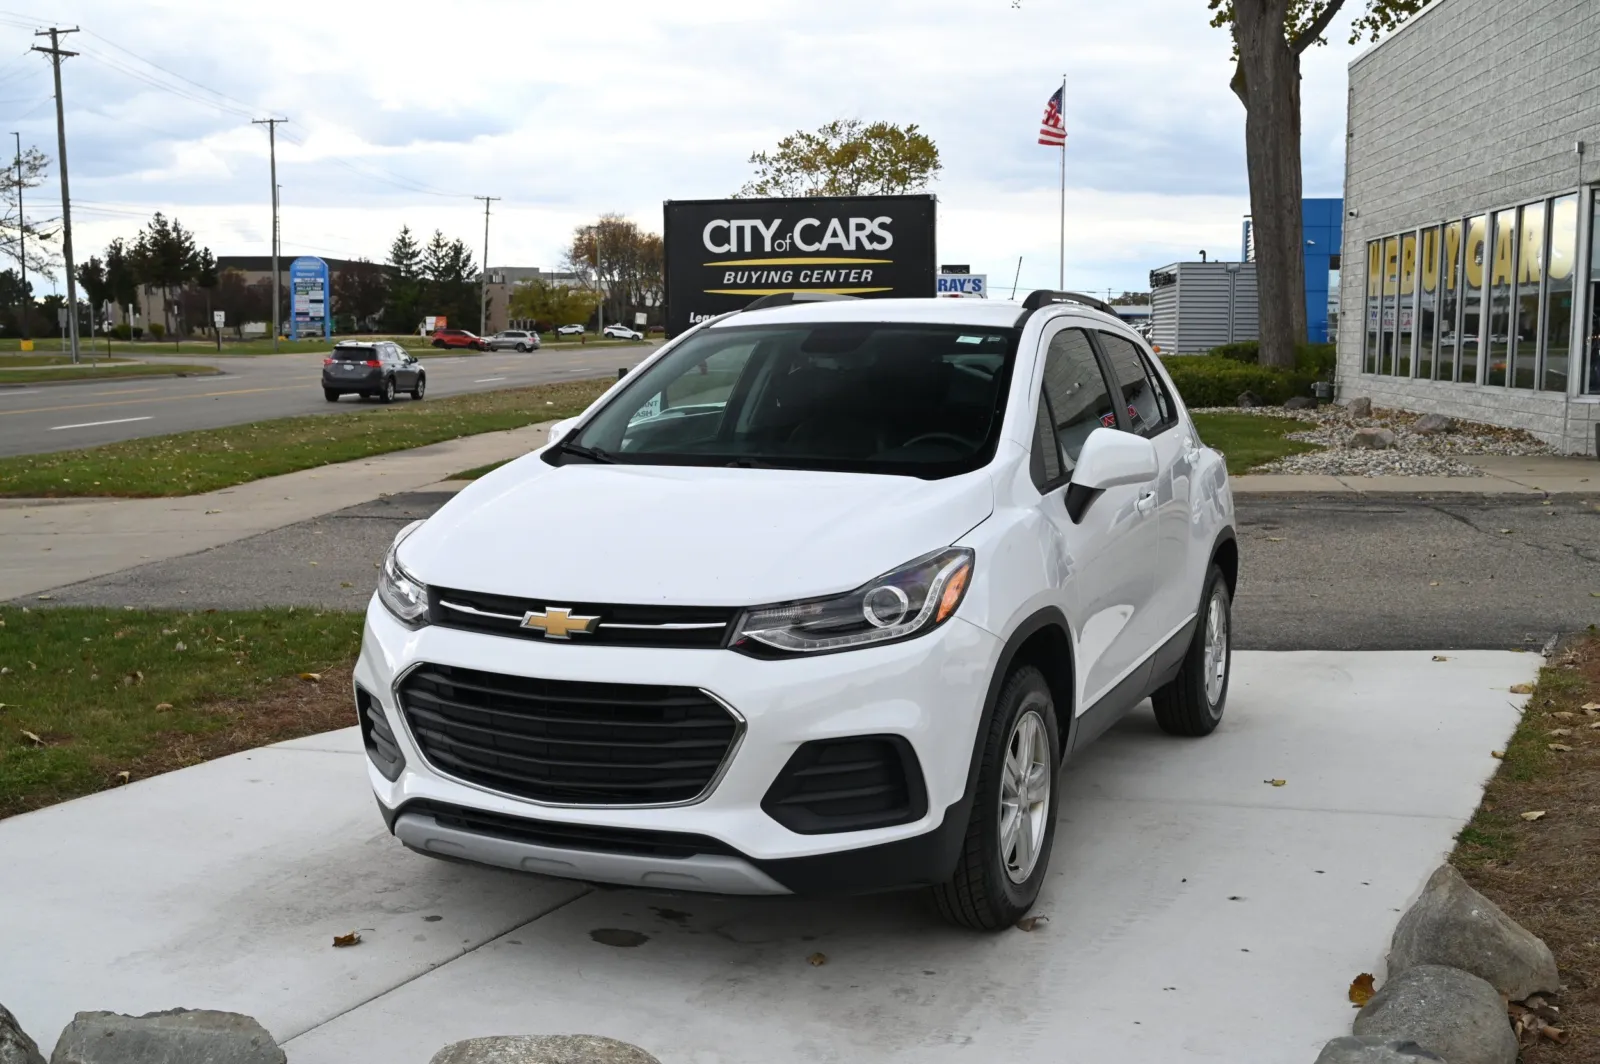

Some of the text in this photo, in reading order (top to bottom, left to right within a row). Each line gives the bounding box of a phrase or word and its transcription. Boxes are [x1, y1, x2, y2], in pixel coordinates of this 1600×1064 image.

[703, 216, 894, 253] CITY of CARS
[1402, 224, 1460, 295] BUY
[723, 269, 873, 284] BUYING CENTER
[938, 278, 982, 292] RAY'S
